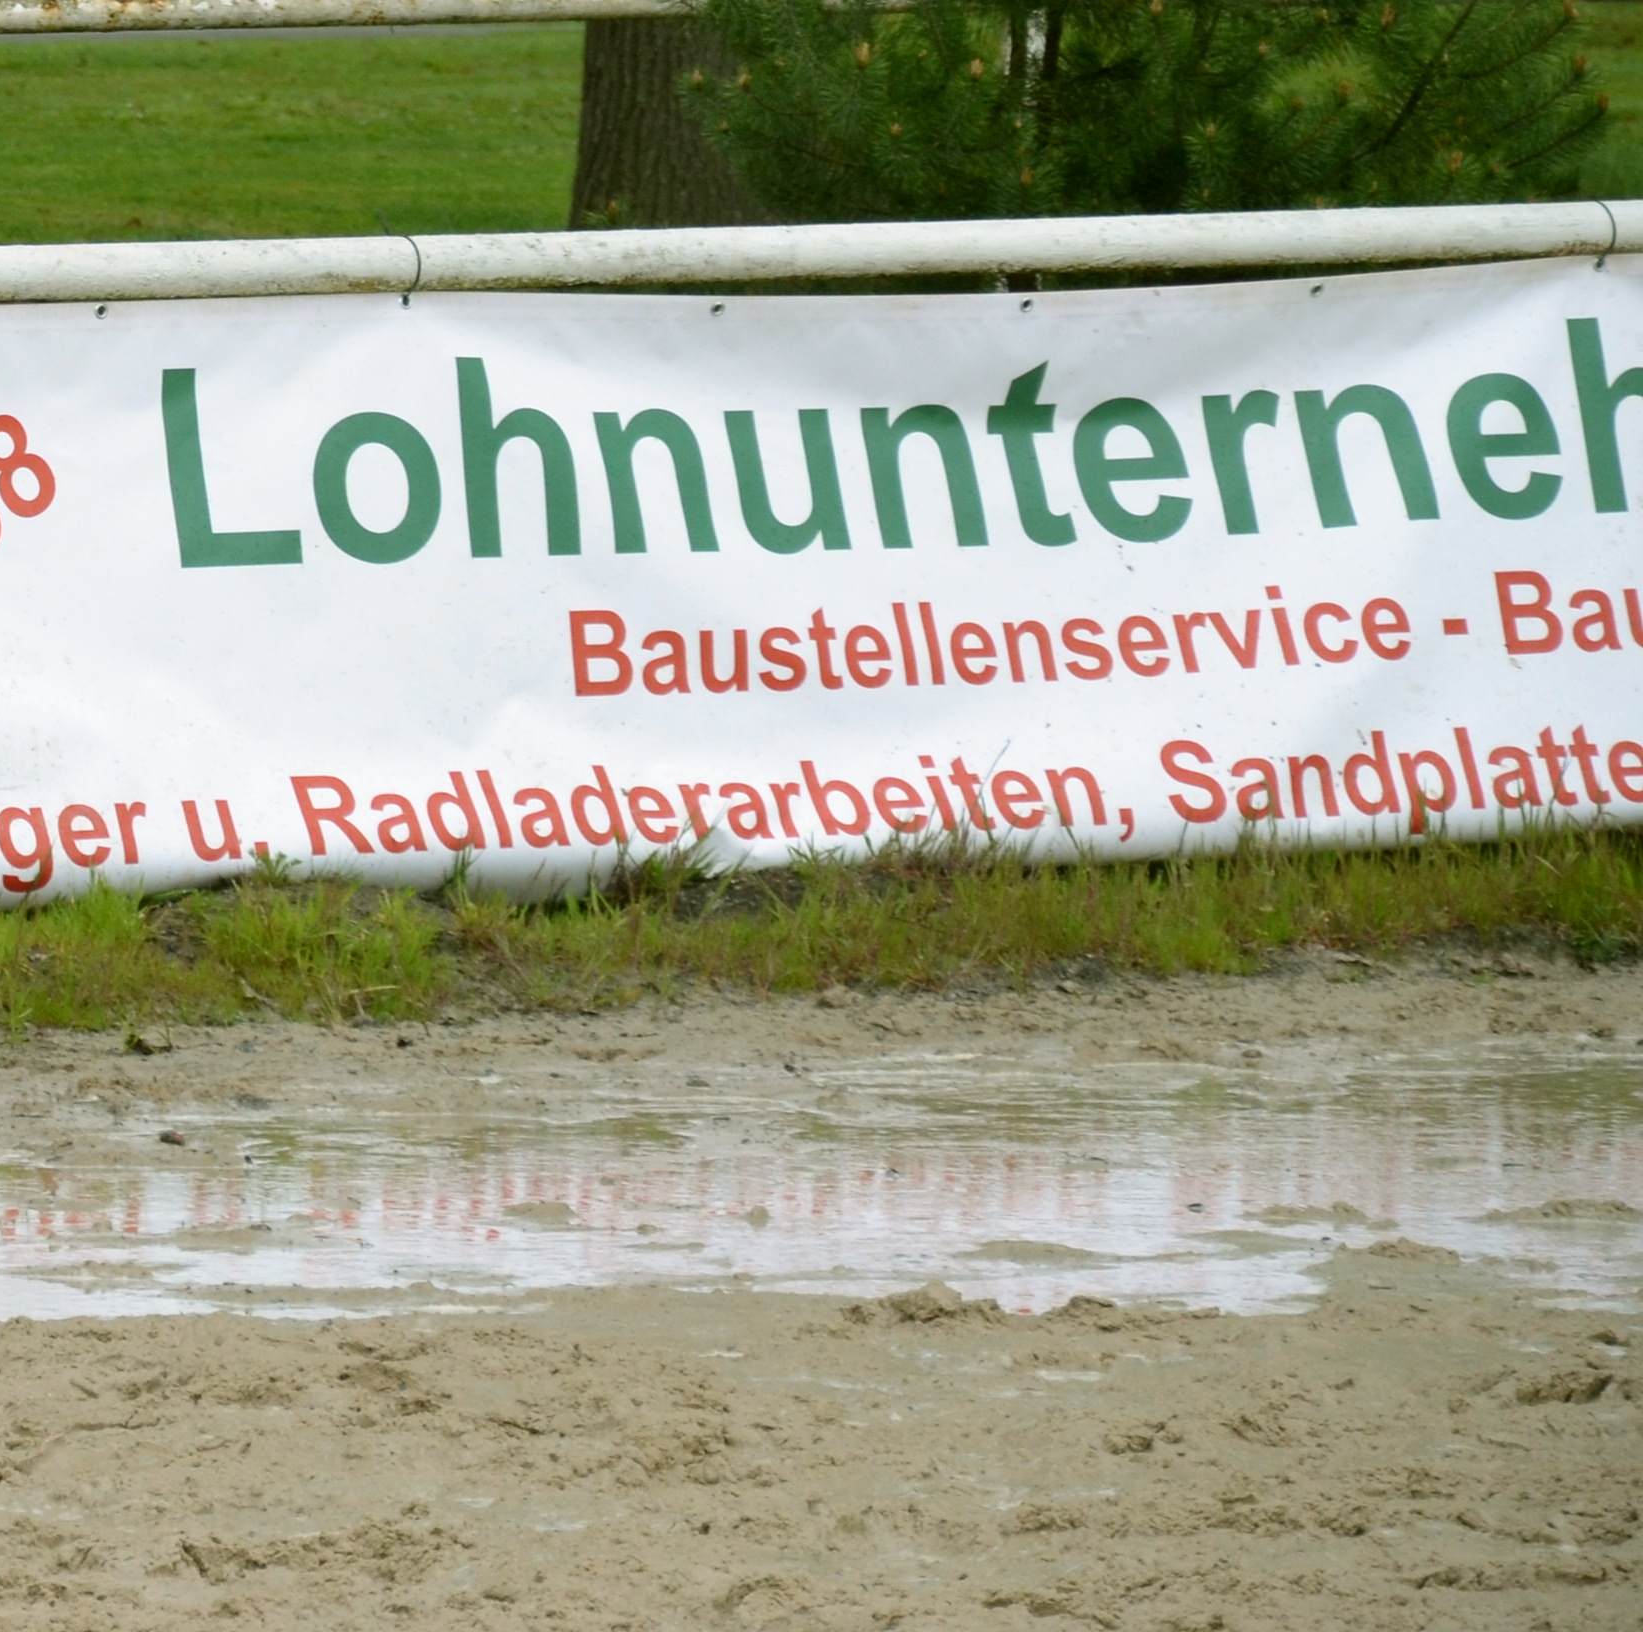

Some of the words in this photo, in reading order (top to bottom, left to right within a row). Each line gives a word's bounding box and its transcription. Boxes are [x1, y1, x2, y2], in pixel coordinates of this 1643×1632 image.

[161, 317, 1643, 568] Lohnunterneh
[568, 583, 1412, 697] Baustellenservice
[181, 799, 272, 862] u.
[289, 754, 1135, 856] Radladerarbeiten,
